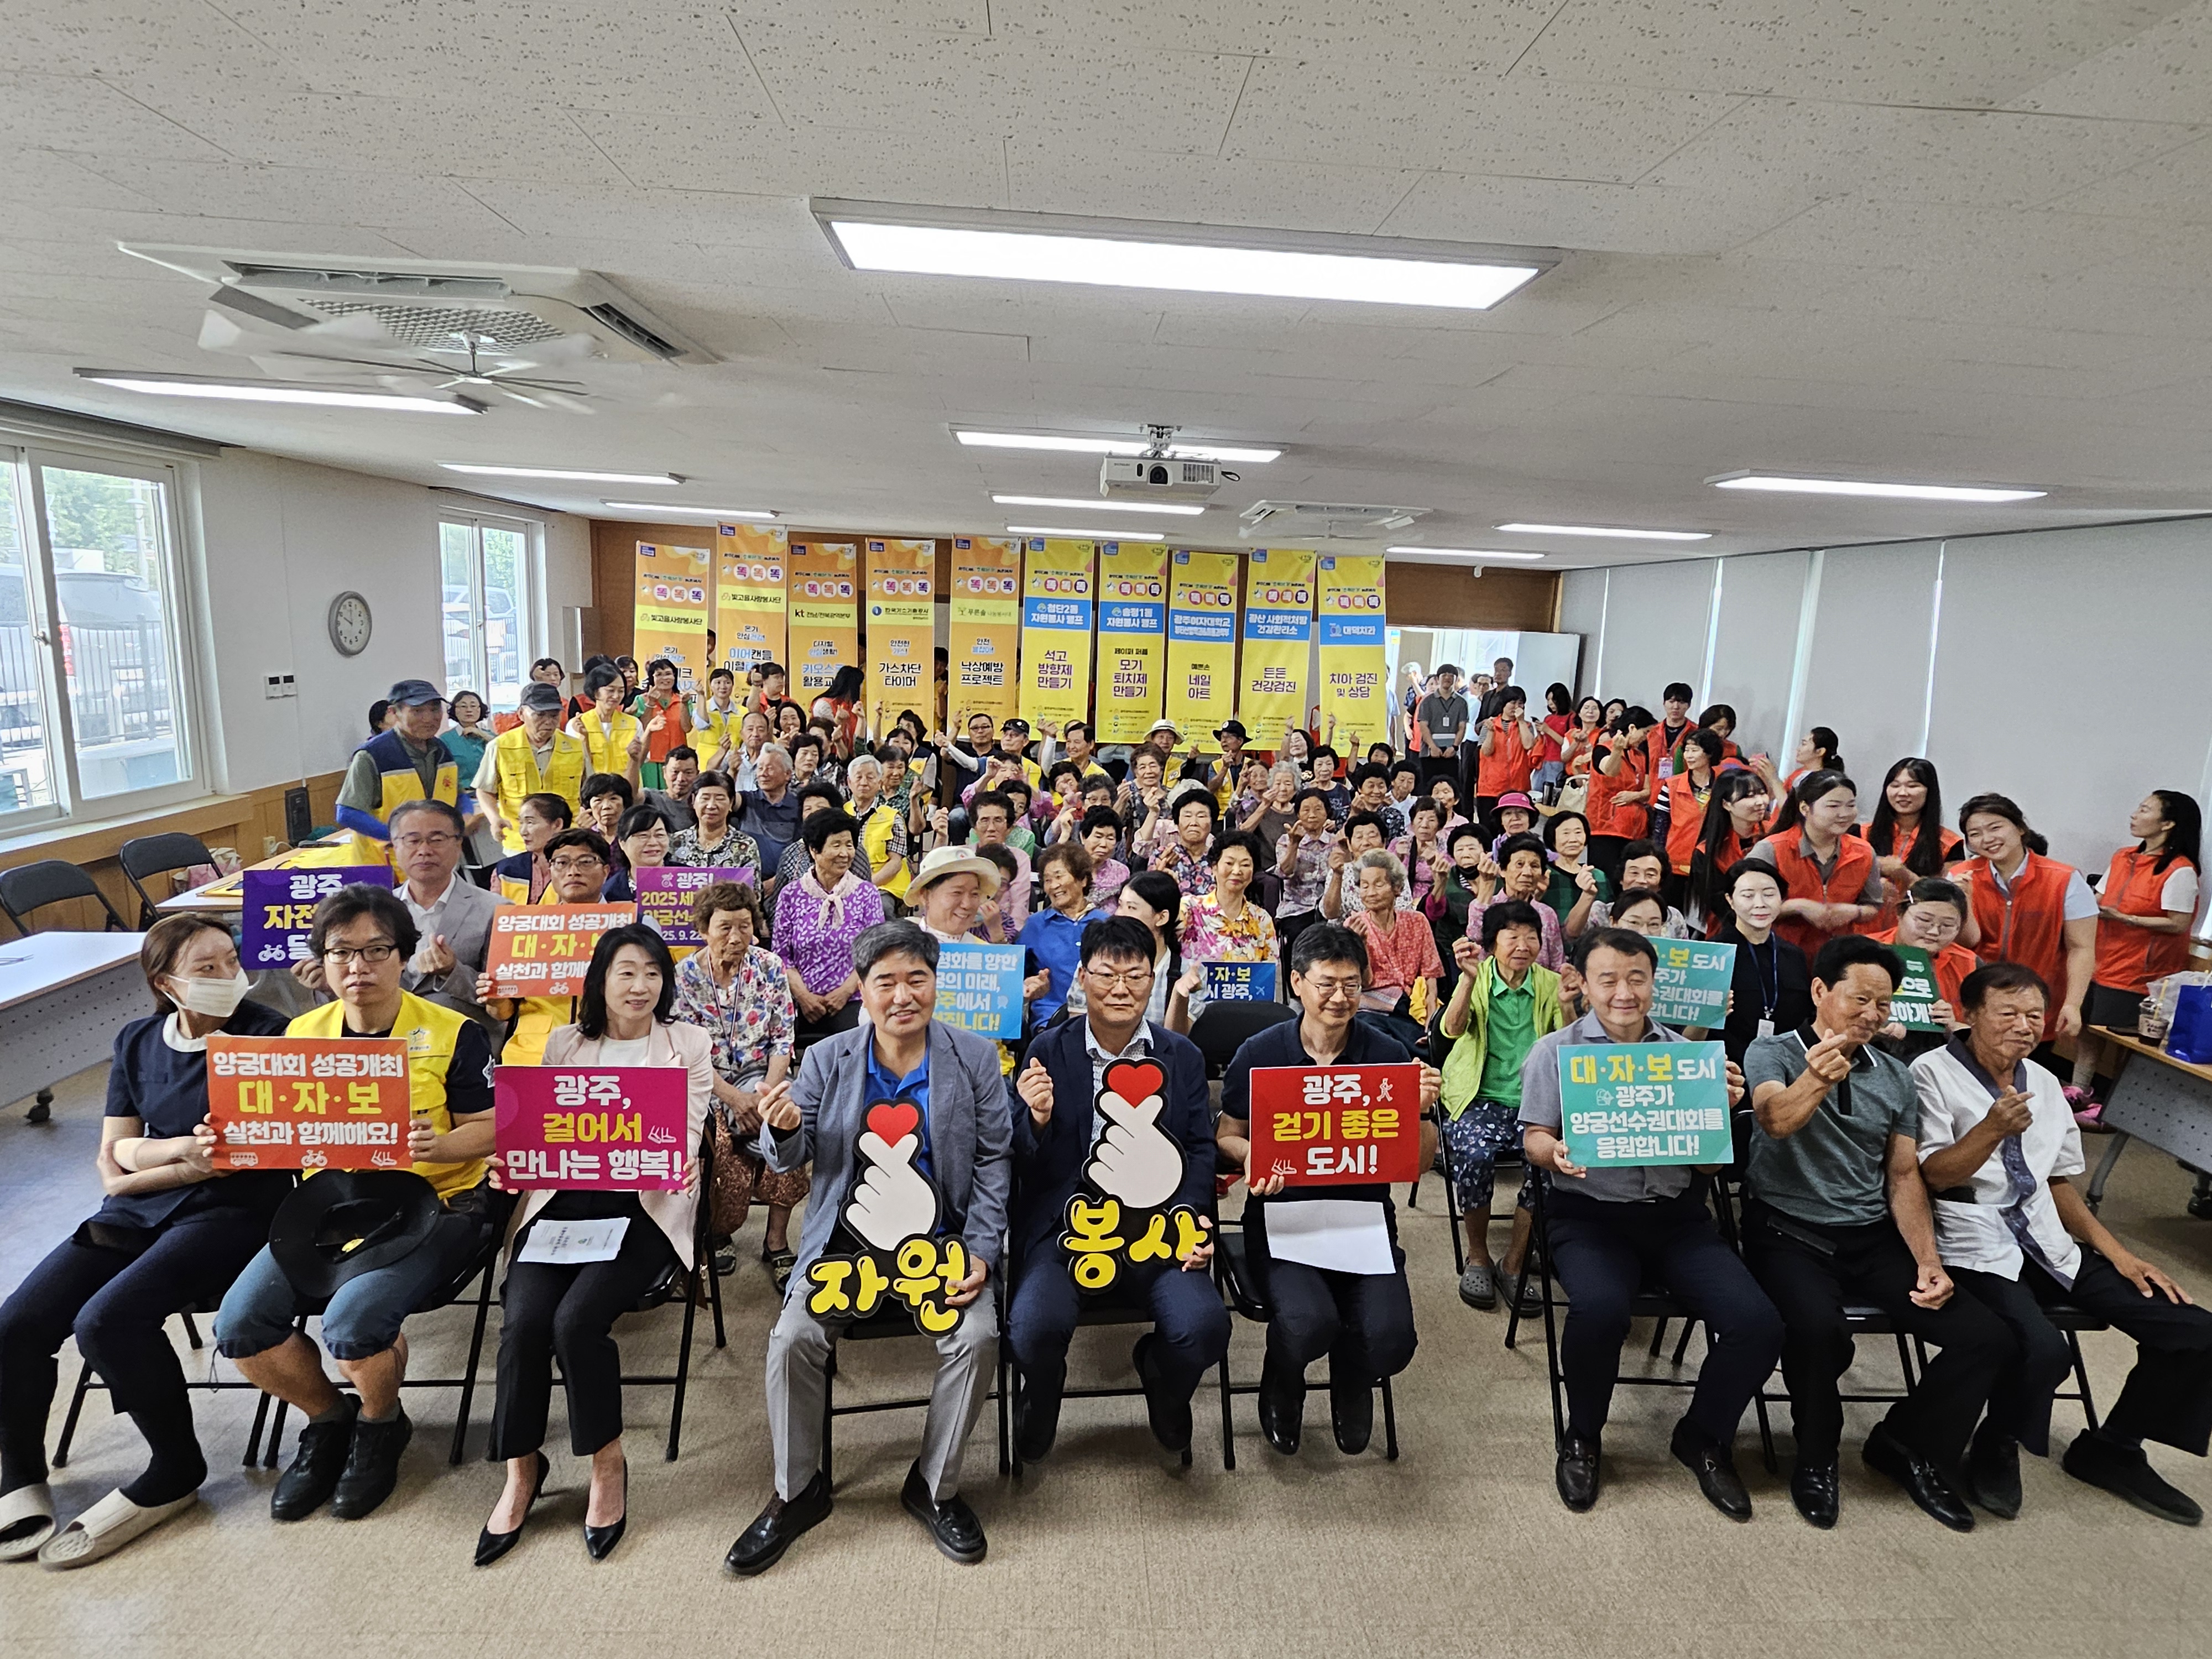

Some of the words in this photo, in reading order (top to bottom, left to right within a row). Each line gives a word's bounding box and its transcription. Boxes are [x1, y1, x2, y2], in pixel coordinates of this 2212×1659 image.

[795, 609, 805, 618] kt
[729, 648, 772, 661] 이어캔들
[1044, 650, 1067, 662] 석고
[879, 663, 921, 674] 가스차단
[961, 661, 1003, 673] 낙상예방
[1038, 663, 1072, 676] 방향제
[1120, 659, 1142, 671] 모기
[1264, 667, 1287, 679] 든든
[803, 676, 834, 687] 활용교
[885, 676, 916, 687] 타이머
[961, 674, 1003, 686] 프로젝트
[1037, 676, 1072, 689] 만들기
[1113, 673, 1147, 685] 퇴치제
[1189, 674, 1211, 686] 네일
[1252, 680, 1296, 693] 건강검진
[1329, 673, 1352, 685] 치아
[1355, 673, 1378, 685] 검진
[1113, 686, 1147, 697] 만들기
[1188, 687, 1211, 700] 아트
[1337, 688, 1345, 697] 및
[1348, 686, 1371, 698] 상담
[289, 874, 343, 899] 광주
[641, 891, 677, 906] 2025
[679, 891, 695, 906] 세
[264, 904, 319, 930] 자전
[497, 914, 565, 932] 양궁대회
[568, 913, 633, 931] 성공개최
[984, 952, 1018, 971] 향한
[1691, 953, 1726, 972] 도시
[495, 962, 549, 980] 실천과
[1206, 966, 1251, 982] ·자·보
[1654, 967, 1687, 985] 주가
[936, 972, 962, 990] 궁의
[965, 973, 1001, 993] 미래,
[1893, 976, 1934, 998] 으로
[1207, 983, 1219, 999] 시
[1221, 983, 1253, 1001] 광주,
[1652, 985, 1724, 1006] 권대회를
[1647, 1002, 1700, 1021] 합니다!
[933, 1011, 1001, 1031] 집니다!
[213, 1052, 306, 1077] 양궁대회
[311, 1052, 404, 1078] 성공개최
[1677, 1057, 1717, 1080] 도시
[554, 1075, 632, 1109] 광주,
[1303, 1074, 1370, 1105] 광주,
[1615, 1084, 1675, 1108] 광주가
[542, 1113, 643, 1144] 걸어서
[1272, 1111, 1331, 1141] 걷기
[1340, 1109, 1399, 1140] 좋은
[1570, 1108, 1724, 1134] 양궁선수권대회를
[223, 1121, 295, 1145] 실천과
[297, 1122, 398, 1146] 함께해요!
[1596, 1134, 1700, 1159] 응원합니다!
[507, 1150, 601, 1180] 만나는
[608, 1150, 682, 1182] 행복!
[1306, 1146, 1378, 1176] 도시!
[1062, 1199, 1208, 1290] 봉사
[809, 1239, 967, 1333] 자원
